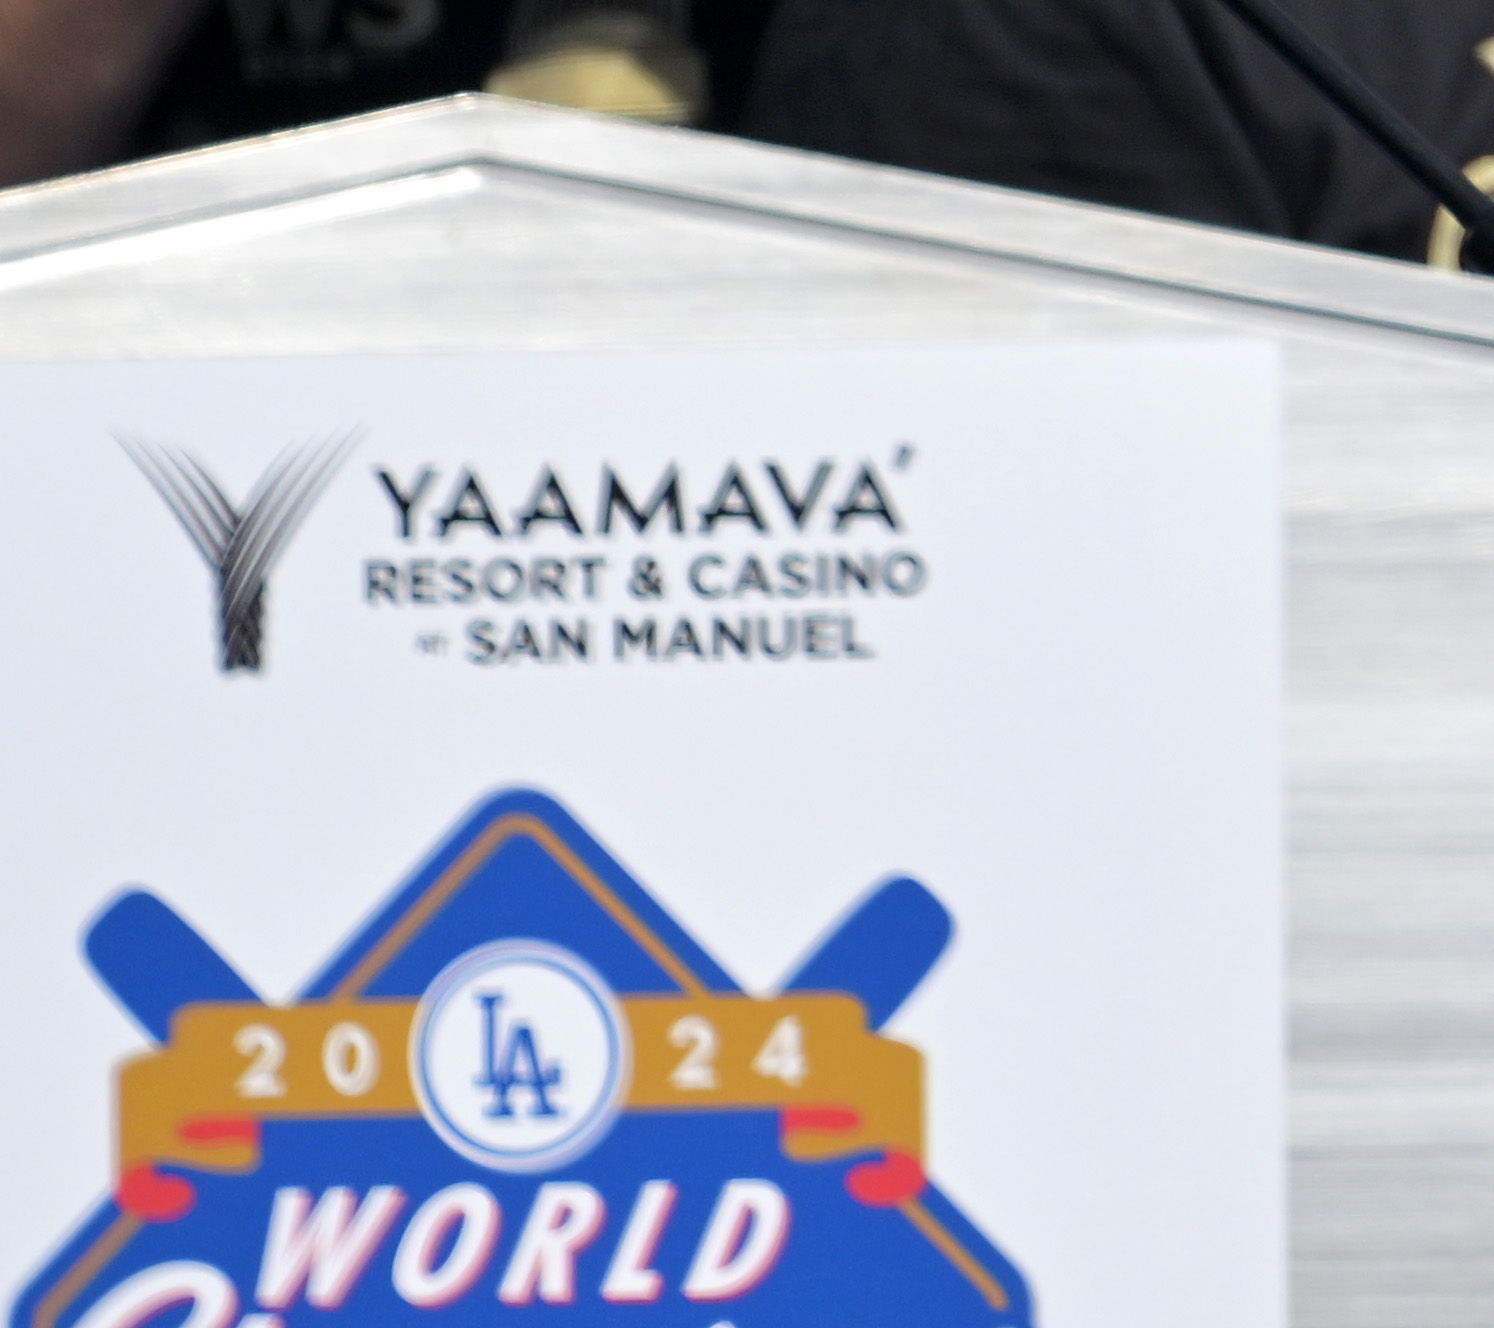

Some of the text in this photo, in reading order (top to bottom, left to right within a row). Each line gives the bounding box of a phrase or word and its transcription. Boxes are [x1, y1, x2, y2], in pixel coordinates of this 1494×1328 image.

[363, 548, 928, 606] RESORT & CASINO
[463, 616, 591, 666] SAN
[611, 611, 879, 663] MANUEL
[473, 988, 563, 1120] LA
[253, 1176, 792, 1312] WORLD
